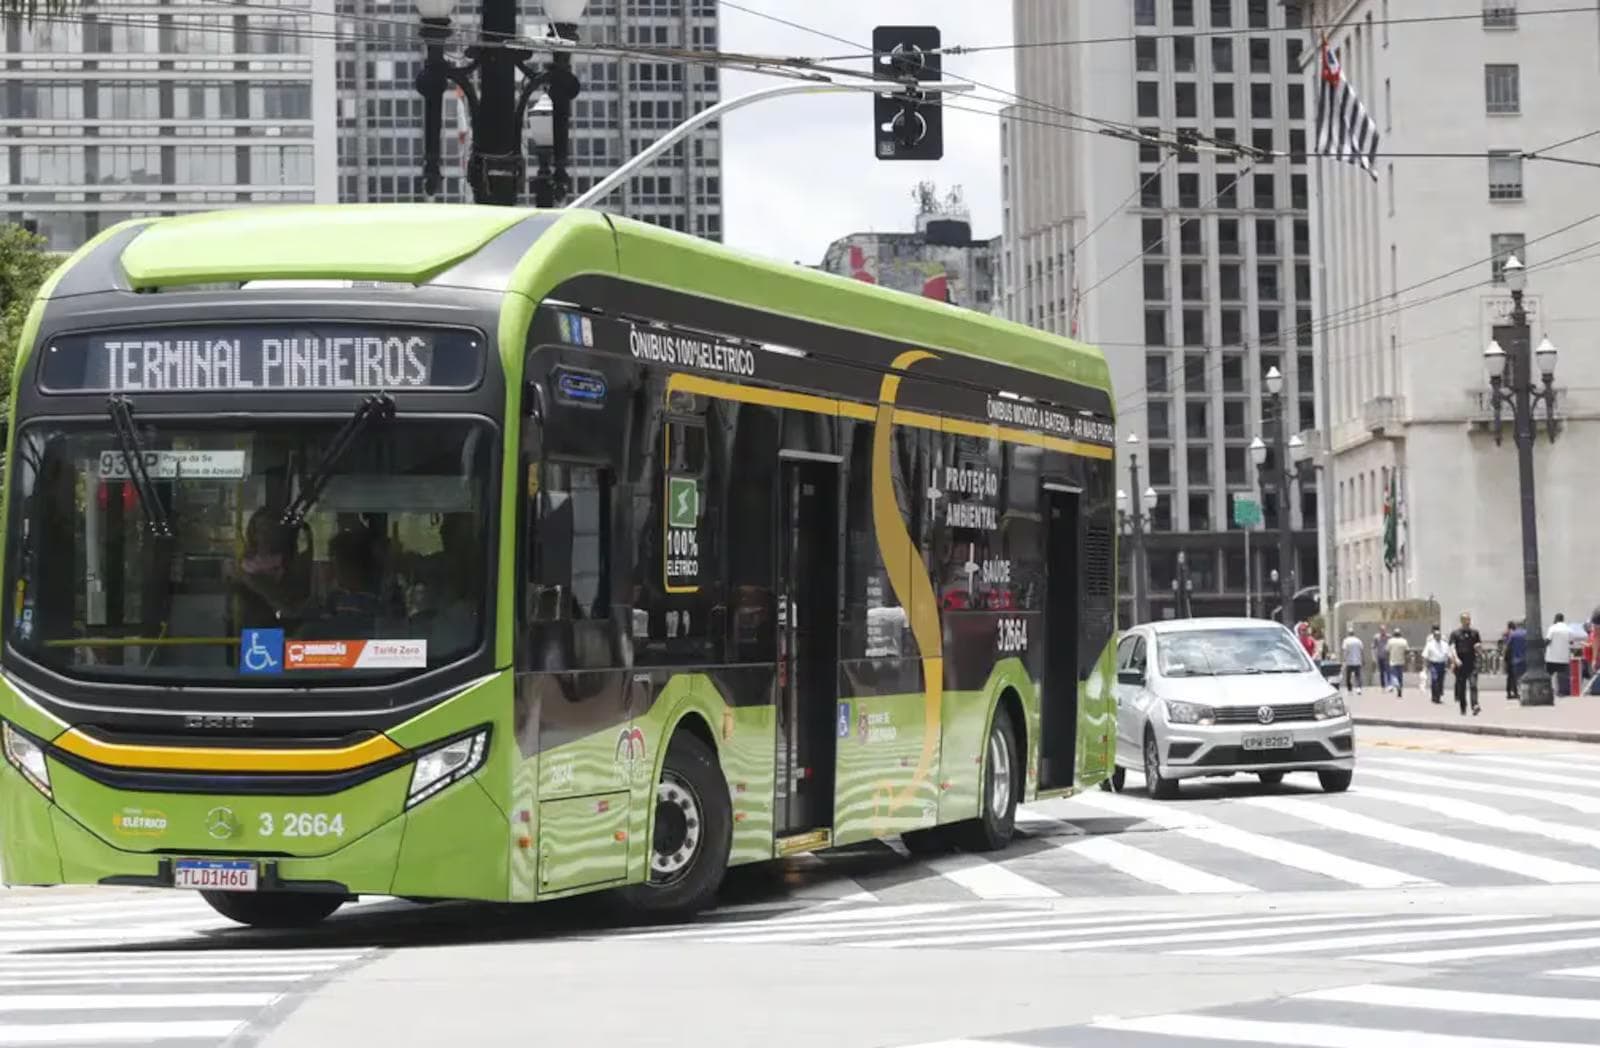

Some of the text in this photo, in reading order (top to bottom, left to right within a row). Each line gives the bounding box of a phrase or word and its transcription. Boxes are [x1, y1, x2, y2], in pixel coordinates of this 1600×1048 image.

[629, 323, 755, 376] ÔNIBUS 100% ELÉTRICO
[104, 337, 427, 390] TERMINAL PINHEIROS
[945, 466, 998, 500] PROTEÇÃO
[946, 503, 998, 530] AMBIENTAL
[667, 530, 699, 556] 100%
[666, 557, 699, 576] ELÉTRICO
[982, 555, 1011, 583] SAÚDE
[1004, 618, 1028, 651] 2664
[399, 646, 420, 655] Zero
[259, 812, 344, 837] 3 2664
